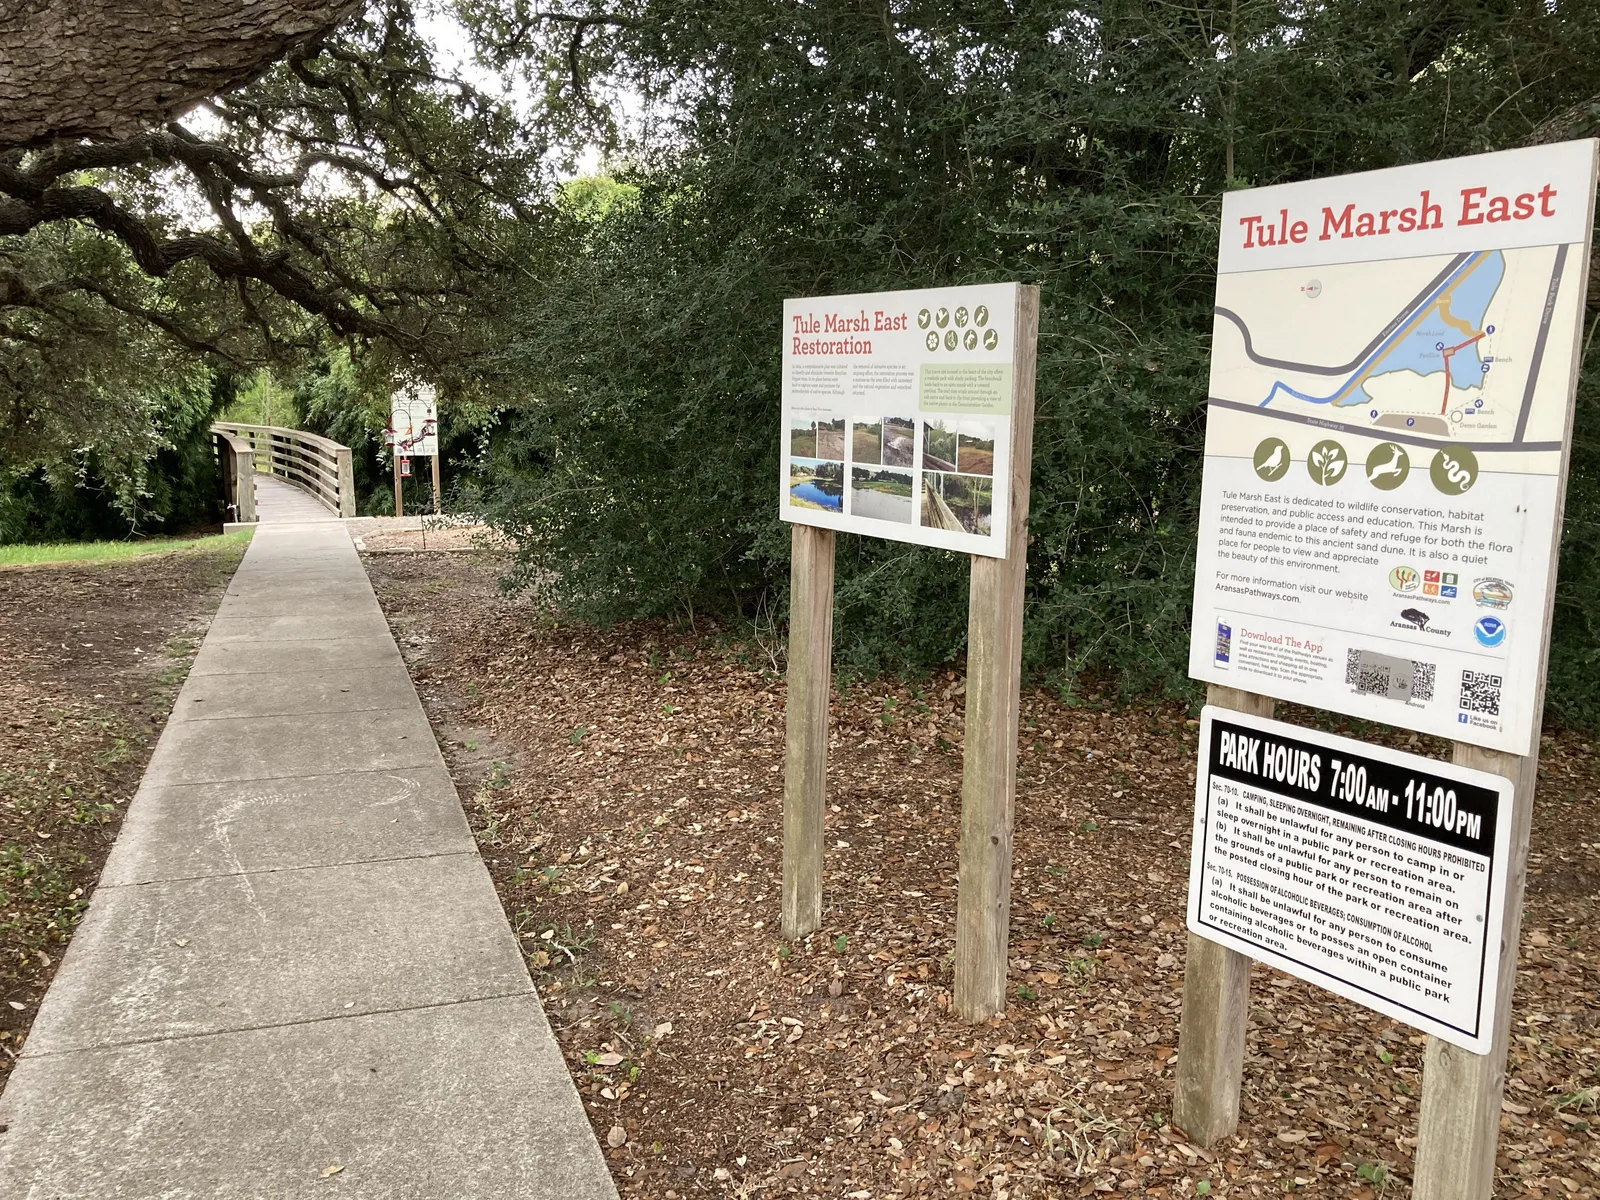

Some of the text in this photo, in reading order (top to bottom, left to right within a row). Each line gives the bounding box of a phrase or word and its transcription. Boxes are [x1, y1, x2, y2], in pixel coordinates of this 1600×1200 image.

[1239, 183, 1557, 248] Tule Marsh East
[792, 311, 907, 334] Tule Marsh East
[1542, 277, 1559, 325] Tule Park Drive
[792, 335, 872, 355] Restoration
[1307, 417, 1319, 425] State
[1319, 420, 1339, 430] Highway
[1221, 504, 1269, 515] preservation,
[1271, 508, 1287, 516] and
[1289, 509, 1314, 519] public
[1316, 513, 1345, 522] access
[1347, 515, 1364, 524] and
[1366, 516, 1414, 528] education.
[1418, 520, 1437, 531] This
[1440, 523, 1471, 534] Marsh
[1222, 490, 1484, 521] Tule Marsh East is dedicated to wildlife conservation, habitat
[1219, 527, 1233, 535] and
[1235, 527, 1256, 537] fauna
[1258, 531, 1292, 542] endemic
[1294, 535, 1303, 543] to
[1305, 536, 1320, 545] this
[1322, 539, 1354, 549] ancient
[1356, 543, 1378, 552] sand
[1380, 544, 1405, 555] dune.
[1409, 547, 1416, 556] It
[1418, 548, 1426, 557] is
[1429, 550, 1449, 560] also
[1461, 554, 1488, 564] quiet
[1220, 515, 1253, 525] intended
[1255, 518, 1263, 526] to
[1265, 520, 1295, 530] provide
[1304, 523, 1327, 533] place
[1329, 525, 1339, 534] of
[1341, 527, 1368, 539] safety
[1370, 531, 1388, 539] and
[1390, 532, 1421, 544] refuge
[1424, 535, 1438, 544] for
[1441, 536, 1465, 547] both
[1468, 540, 1485, 550] the
[1488, 541, 1513, 553] flora
[1240, 628, 1323, 654] Download The App
[1390, 620, 1451, 637] Aransas County
[1469, 719, 1496, 730] Facebook
[1219, 730, 1260, 775] PARK
[1262, 741, 1321, 792] HOURS
[1212, 781, 1485, 872] Sec. 70-10. CAMPING, SLEEPING OVERNIGHT, REMAINING AFTER CLOSING HOURS PROHIBITED
[1217, 796, 1464, 881] (a) It shall be unlawful for any person to camp in or
[1216, 821, 1458, 909] (b) It shall be unlawful for any person to remain on
[1217, 809, 1238, 823] sleep
[1240, 818, 1280, 835] overnight
[1283, 829, 1291, 839] in
[1301, 838, 1329, 852] public
[1332, 847, 1354, 860] park
[1356, 855, 1367, 863] or
[1370, 860, 1424, 883] recreation
[1427, 878, 1455, 893] area.
[1214, 846, 1471, 944] the posted closing hour of the park or recreation area.
[1215, 833, 1228, 843] the
[1230, 840, 1264, 856] grounds
[1267, 852, 1275, 860] of
[1285, 859, 1312, 873] public
[1315, 869, 1336, 882] park
[1339, 877, 1349, 885] or
[1352, 882, 1404, 905] recreation
[1408, 901, 1432, 915] area
[1435, 911, 1462, 925] after
[1212, 876, 1448, 972] (a) It shall be unlawful for any person to consume
